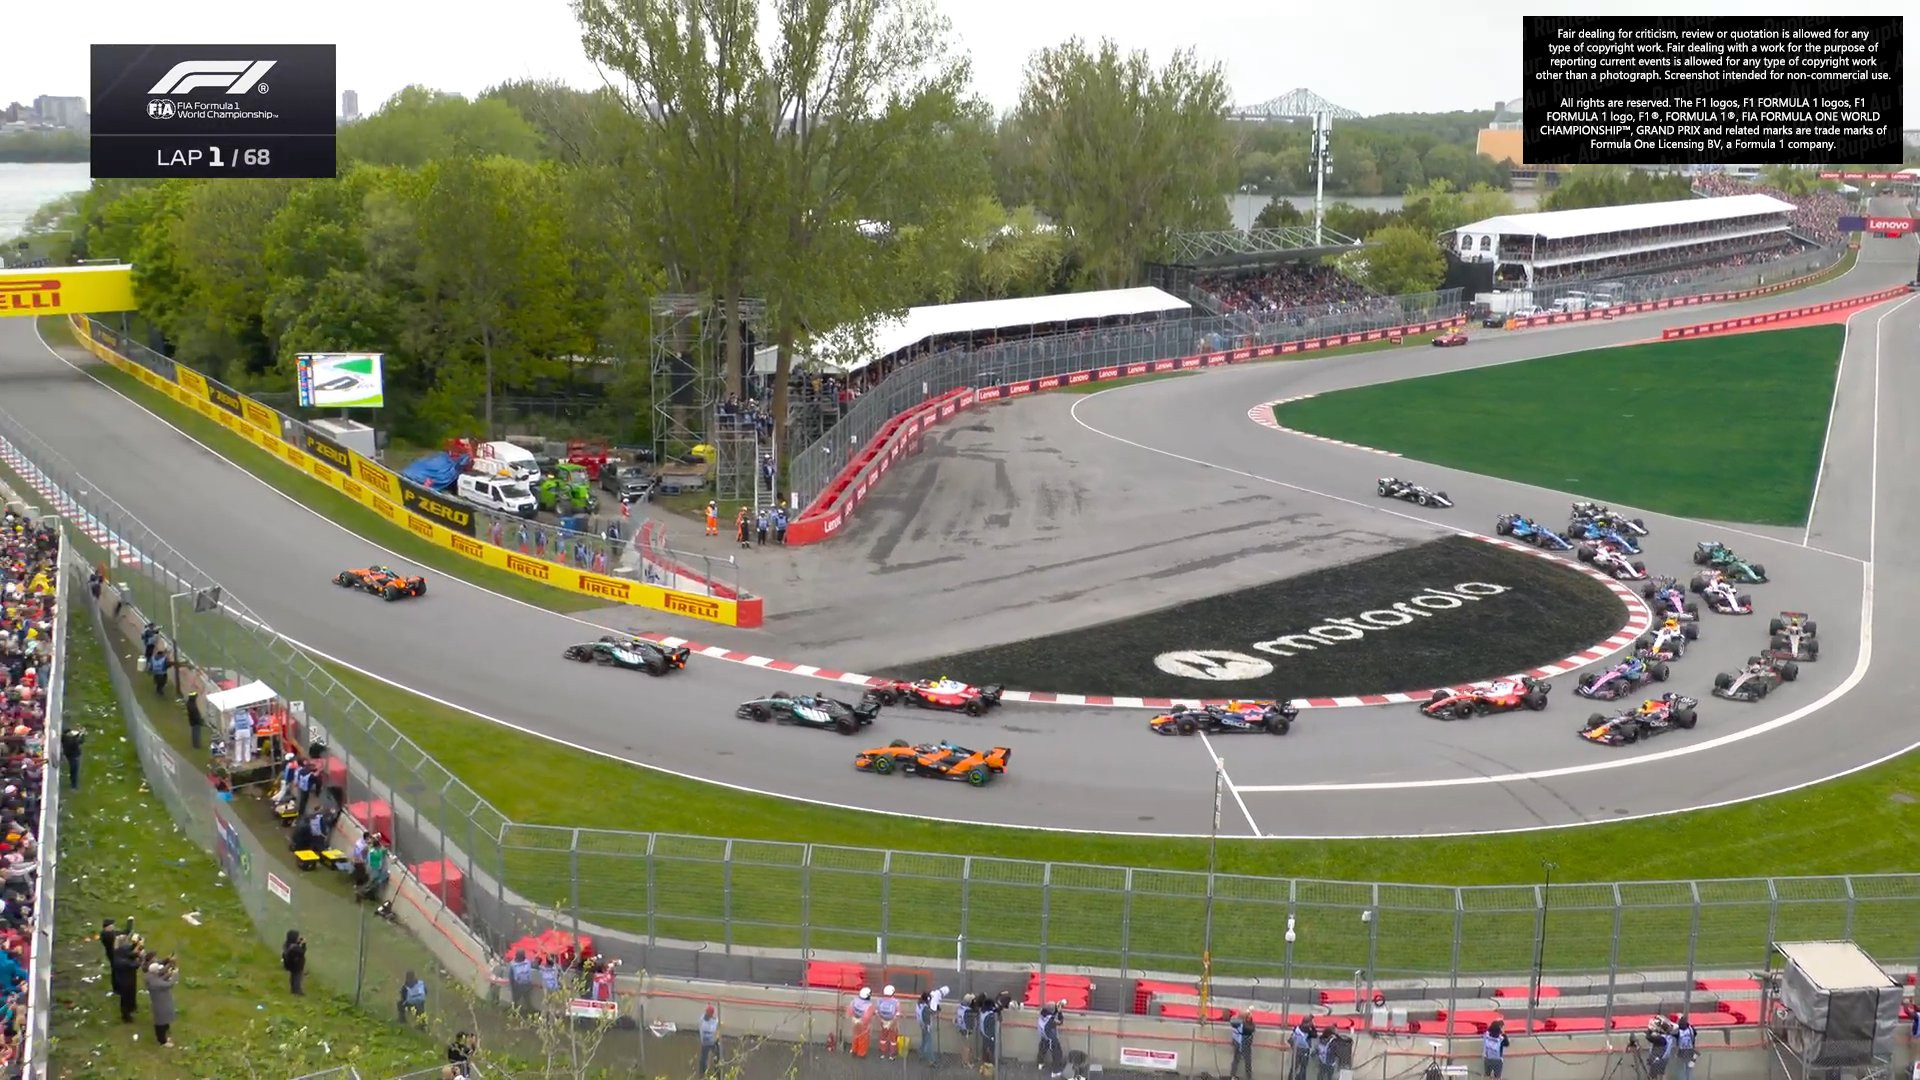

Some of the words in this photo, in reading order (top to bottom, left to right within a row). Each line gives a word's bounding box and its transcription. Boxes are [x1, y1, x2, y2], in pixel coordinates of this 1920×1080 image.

[1870, 220, 1909, 229] Lenovo
[1208, 354, 1225, 363] Lenovo
[1099, 370, 1118, 378] Lenovo
[1128, 365, 1146, 374] Lenovo
[1039, 378, 1059, 388] Lenovo
[1069, 374, 1089, 383] Lenovo
[980, 389, 999, 399] Lenovo
[1010, 383, 1030, 394] Lenovo
[316, 442, 348, 466] ZERO
[358, 461, 390, 494] PIRELLI
[404, 489, 416, 501] P
[418, 497, 470, 527] ZERO
[451, 534, 483, 559] PIRELLI
[507, 555, 549, 580] PIRELLI
[579, 575, 631, 599] PIRELLI
[664, 593, 719, 618] PIRELLI
[1253, 582, 1513, 656] motorola
[1221, 718, 1251, 728] ORACLE
